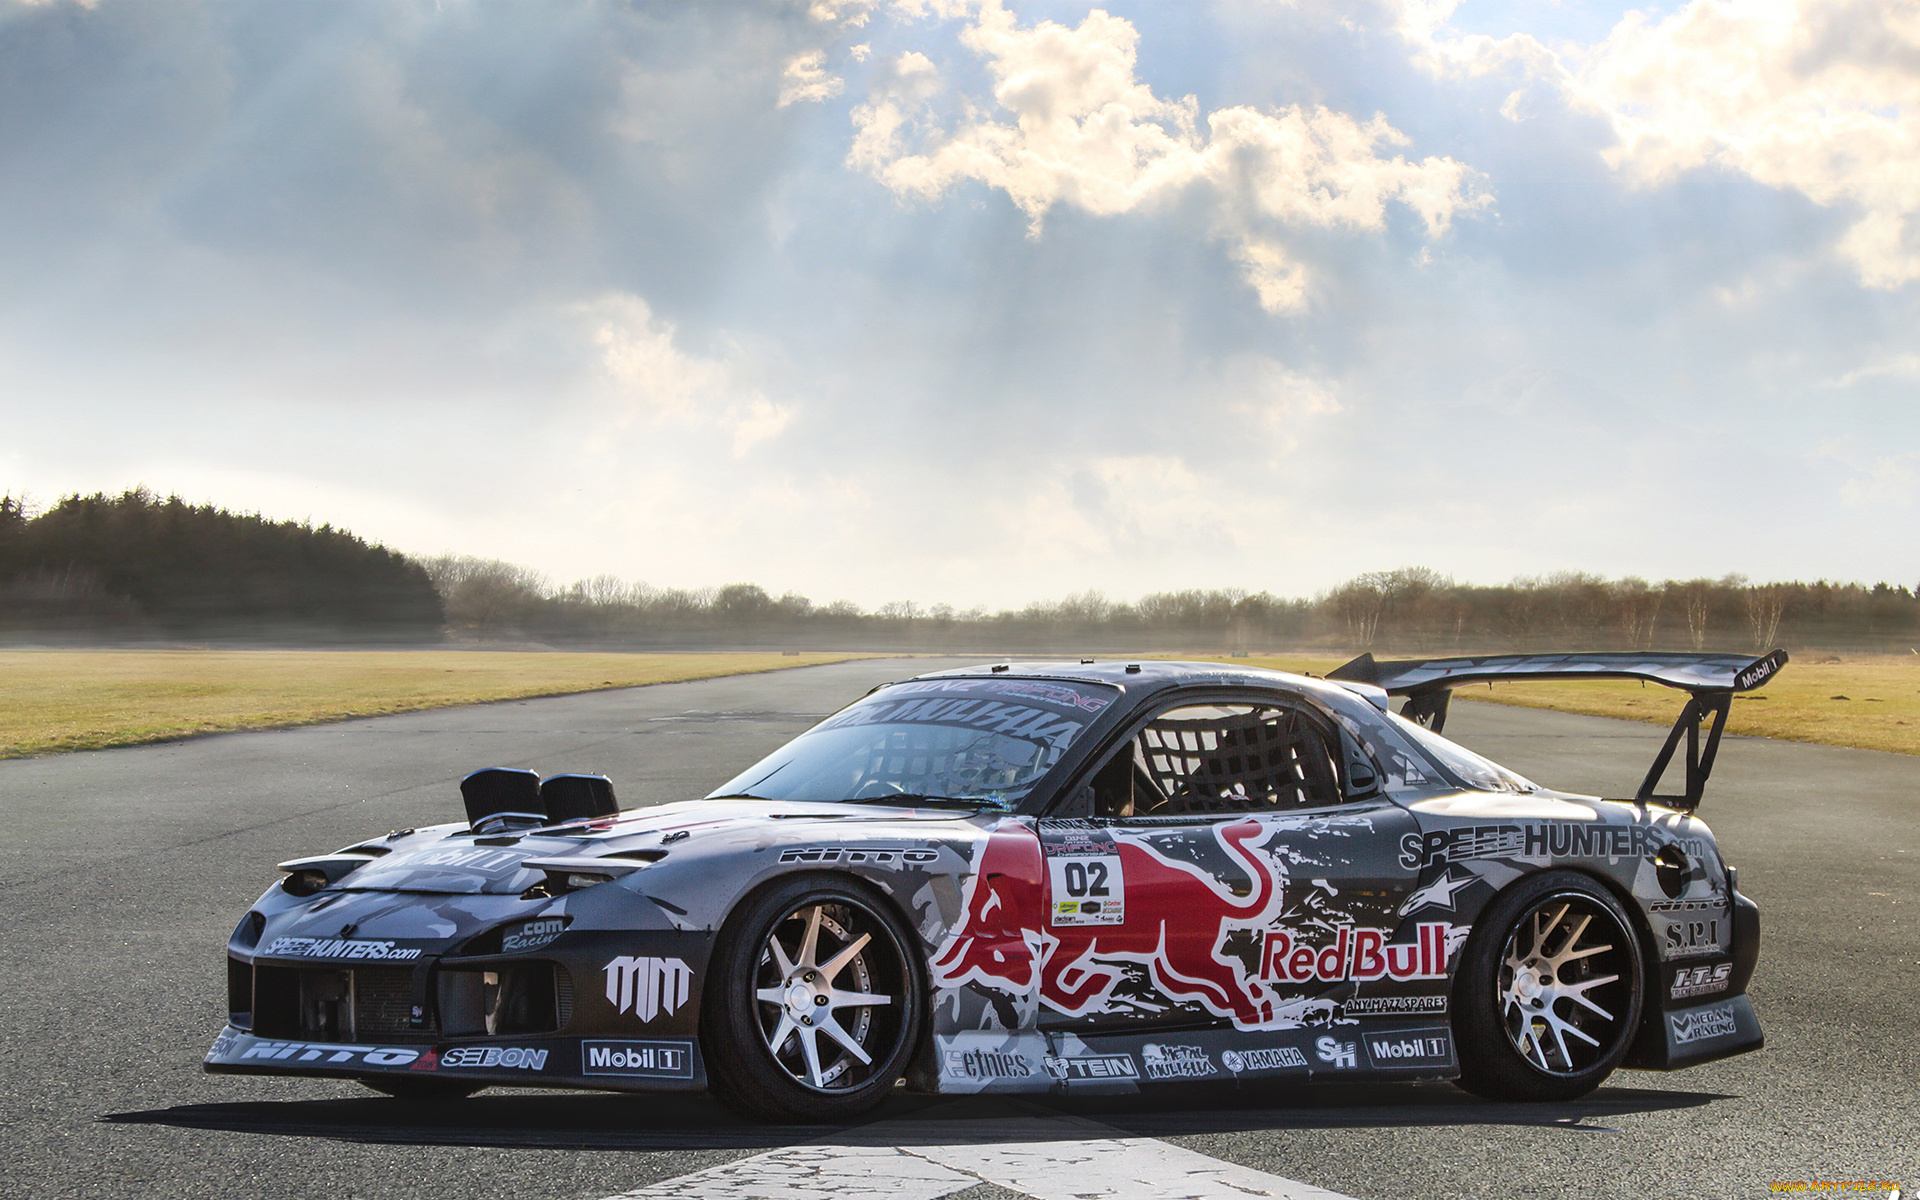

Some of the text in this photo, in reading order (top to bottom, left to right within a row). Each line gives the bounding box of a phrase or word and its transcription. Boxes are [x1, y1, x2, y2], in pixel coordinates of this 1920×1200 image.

[1742, 661, 1771, 689] Mobil
[778, 847, 939, 863] NITTO
[1043, 842, 1118, 855] DRIFTING
[1399, 823, 1704, 871] SPEEDHUNTERSom
[1064, 862, 1110, 898] 02
[1649, 898, 1728, 912] NITTO
[520, 920, 564, 936] .com
[1665, 919, 1718, 949] S.P.I
[264, 937, 422, 960] SPEEDHUNTERS.com
[1259, 923, 1446, 981] Red Bull
[1347, 997, 1445, 1010] ANY MAZZ SPARES
[1690, 1008, 1733, 1025] MEGAN
[1692, 1021, 1735, 1038] RACING
[240, 1042, 419, 1066] NITTO
[441, 1047, 549, 1070] SEIBON
[590, 1048, 655, 1069] Mobil
[1240, 1048, 1307, 1070] YAMAHA
[1317, 1038, 1356, 1068] SH
[1373, 1039, 1426, 1058] Mobil
[963, 1048, 1030, 1077] etnies
[1070, 1058, 1136, 1077] TEIN
